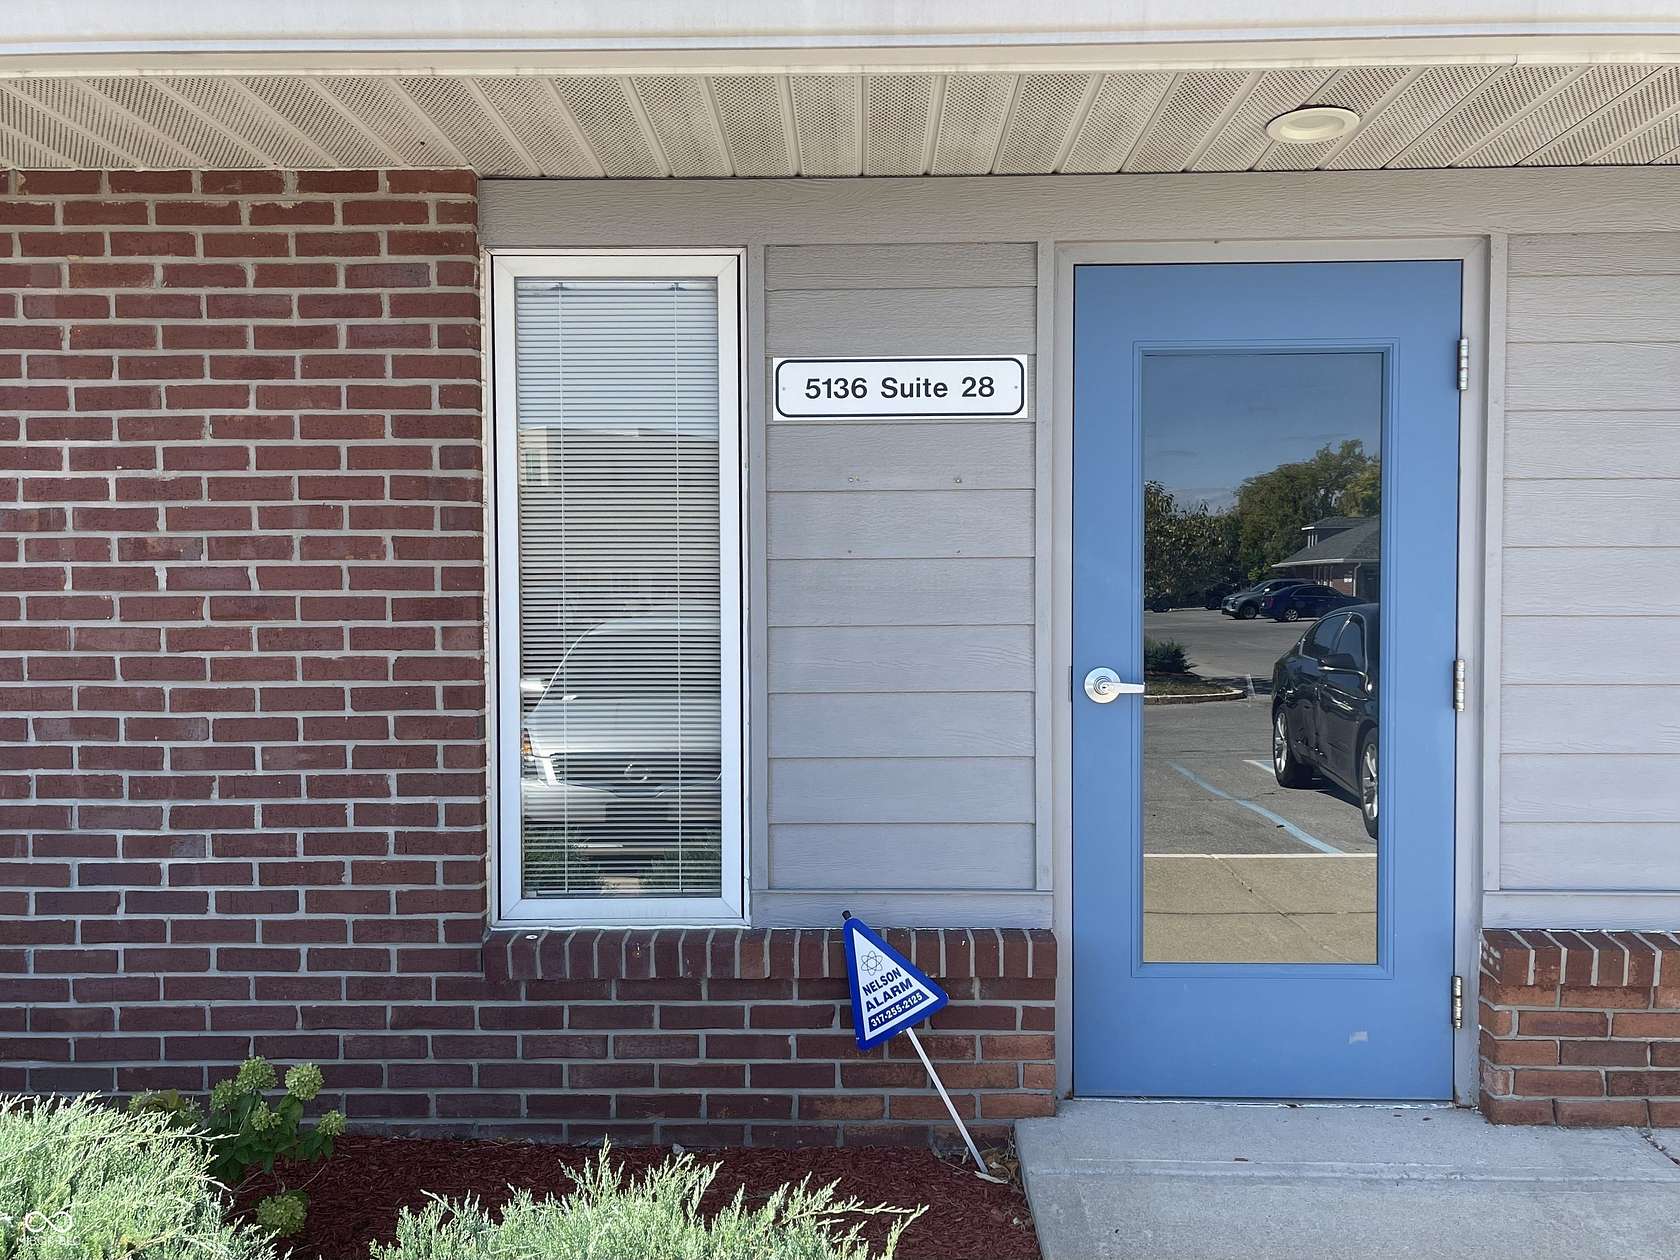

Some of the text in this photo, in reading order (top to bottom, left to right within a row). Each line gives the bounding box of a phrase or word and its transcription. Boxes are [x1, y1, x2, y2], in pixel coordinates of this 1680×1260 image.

[805, 376, 995, 400] 5136 Suite 28
[862, 967, 902, 996] NELSON
[866, 977, 913, 1012] ALARM
